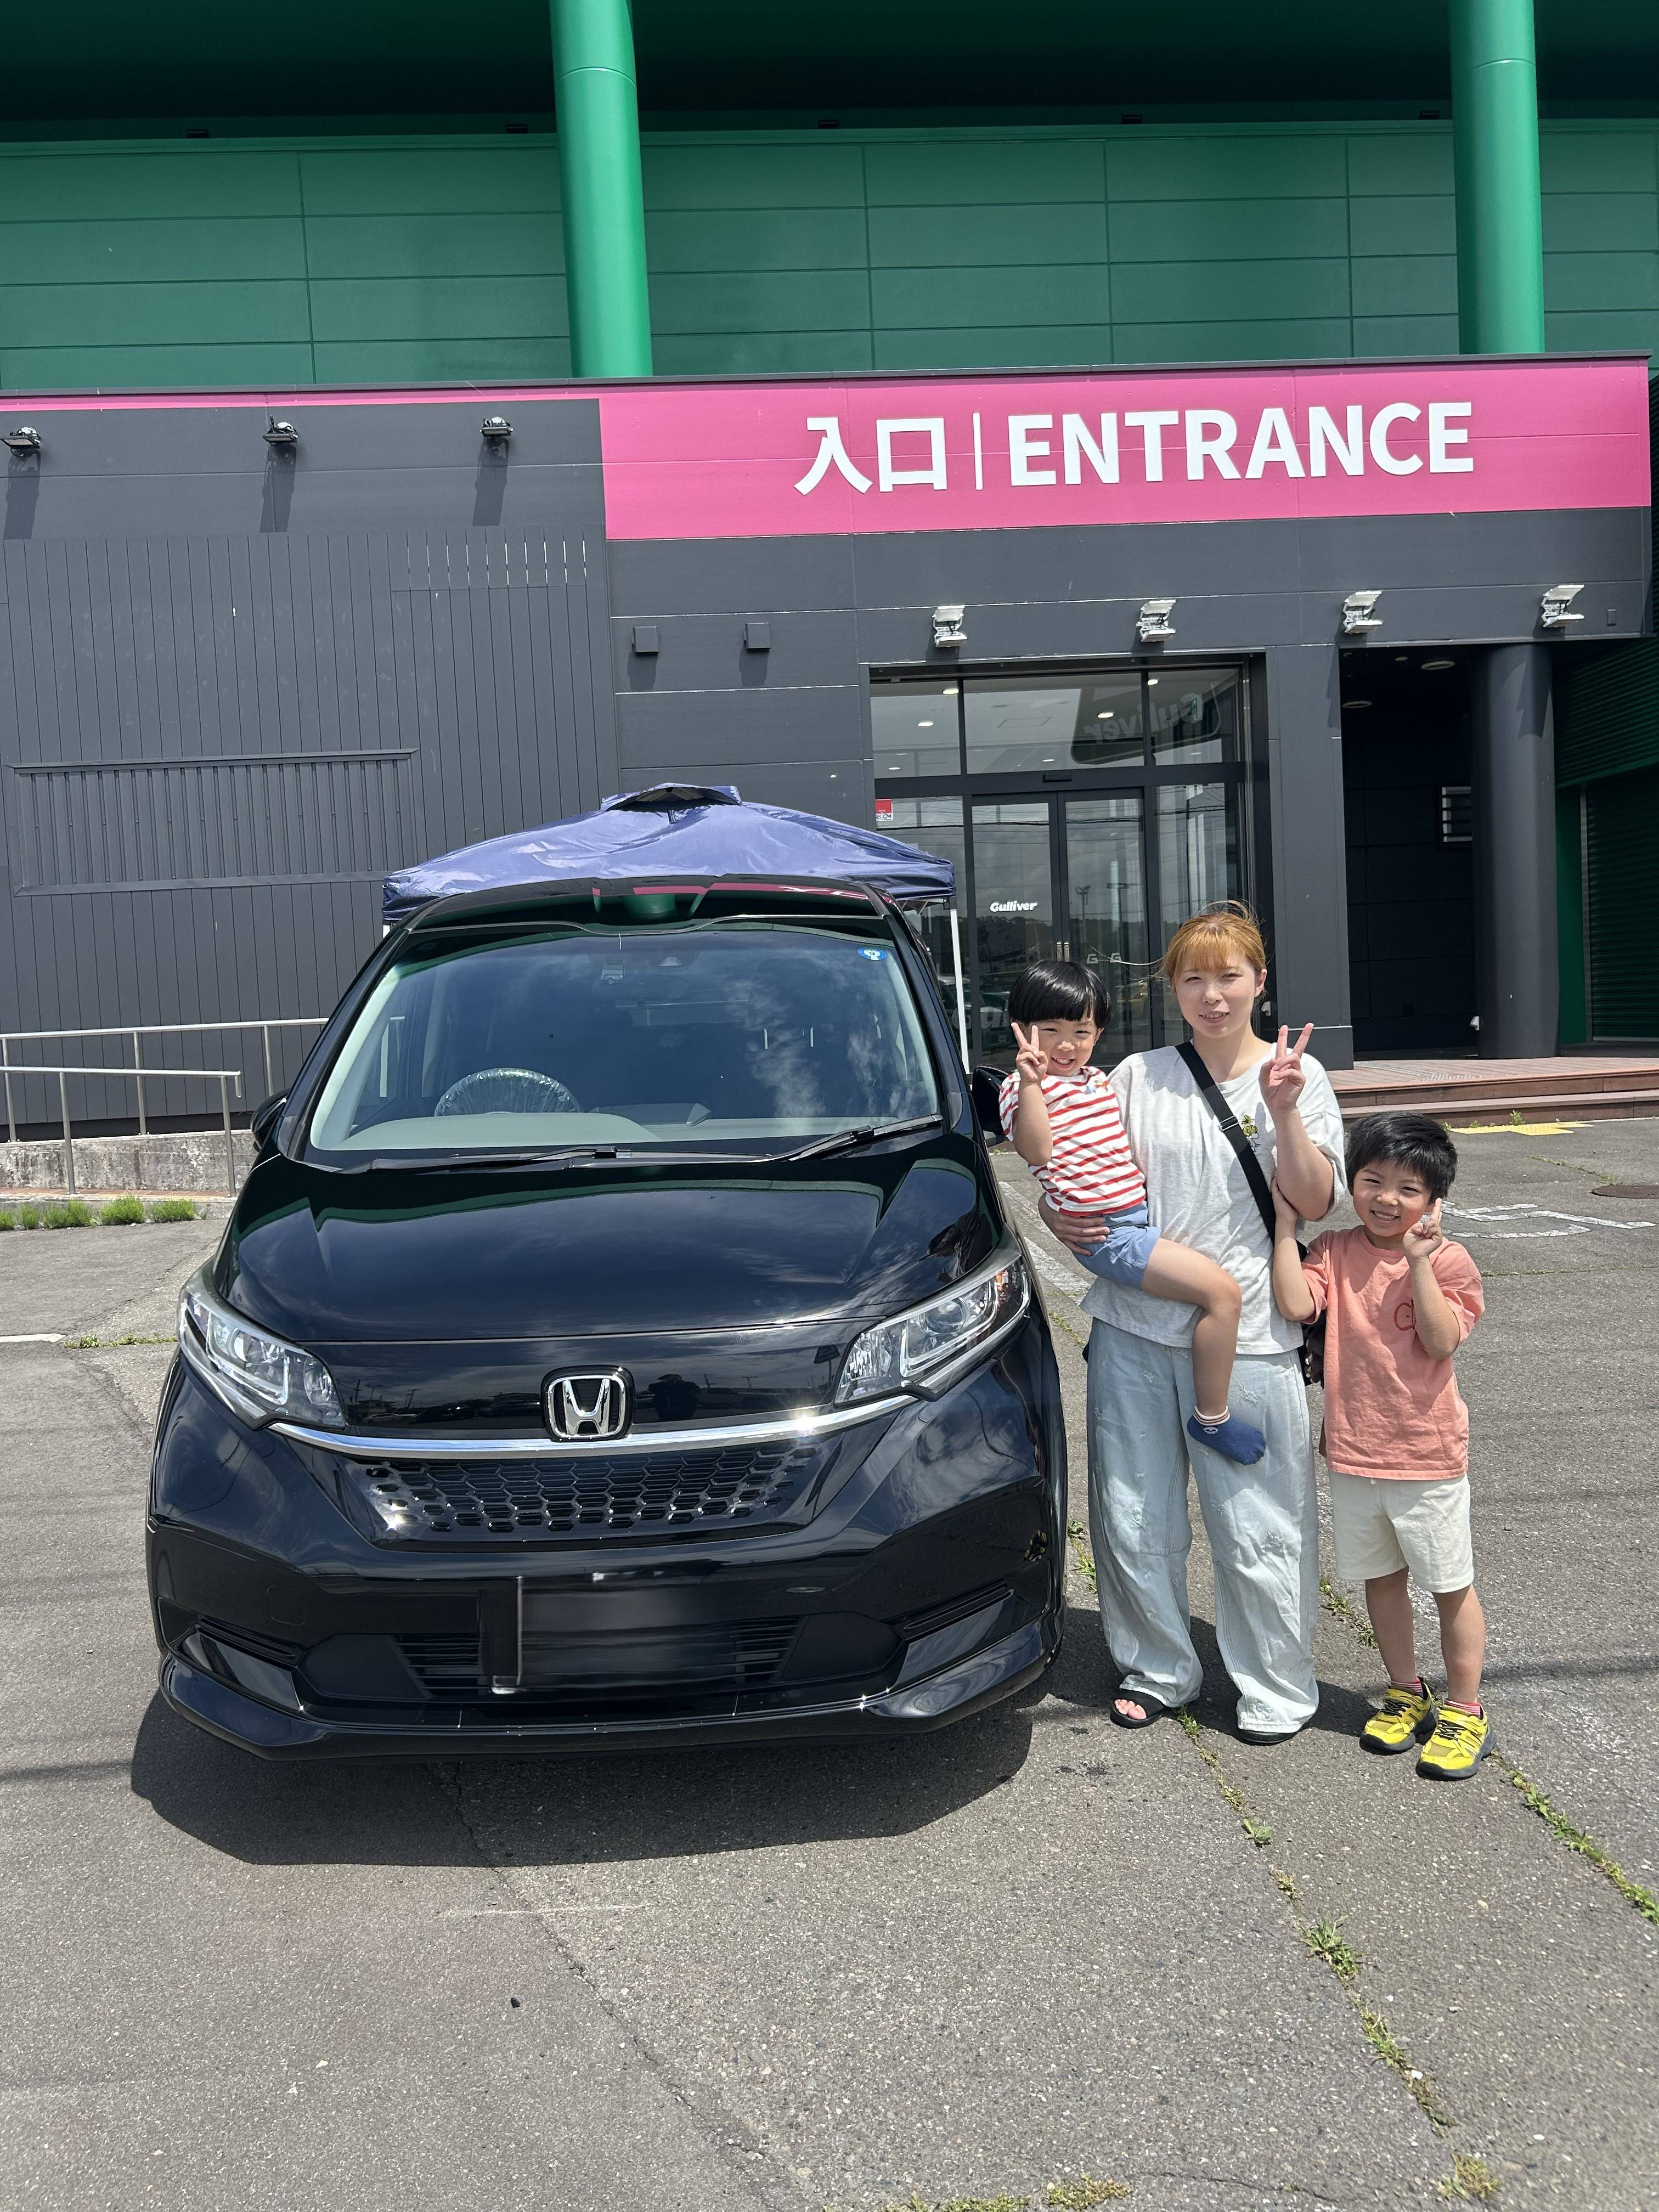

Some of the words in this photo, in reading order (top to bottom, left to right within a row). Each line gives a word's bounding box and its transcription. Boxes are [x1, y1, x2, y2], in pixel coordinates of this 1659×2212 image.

[793, 417, 947, 495] 入口
[1008, 402, 1474, 486] ENTRANCE
[990, 900, 1037, 912] Gulliver
